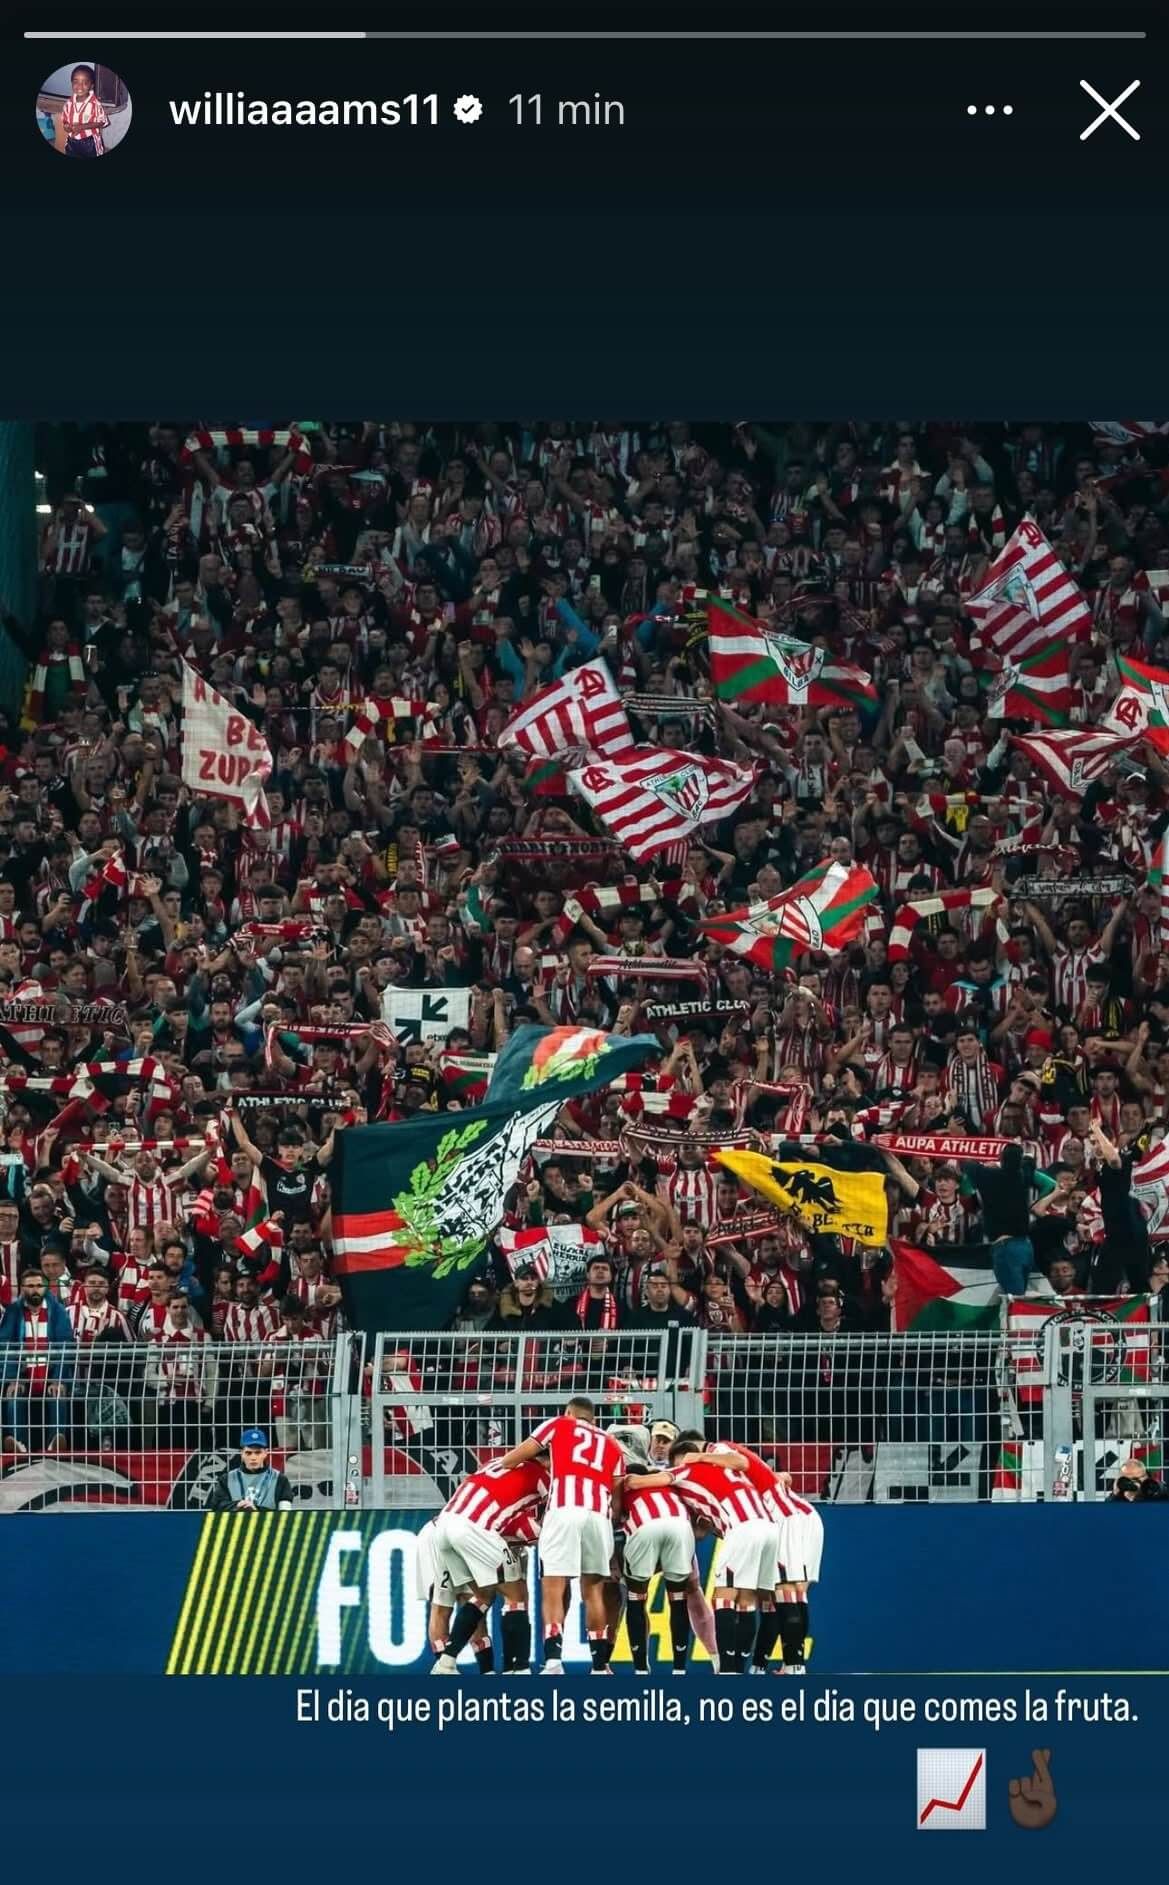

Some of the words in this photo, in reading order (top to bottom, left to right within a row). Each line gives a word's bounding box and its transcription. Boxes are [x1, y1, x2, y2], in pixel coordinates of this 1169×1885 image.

[647, 1001, 712, 1018] ATHLETIC
[895, 1136, 937, 1151] AUPA
[571, 1426, 607, 1473] 21
